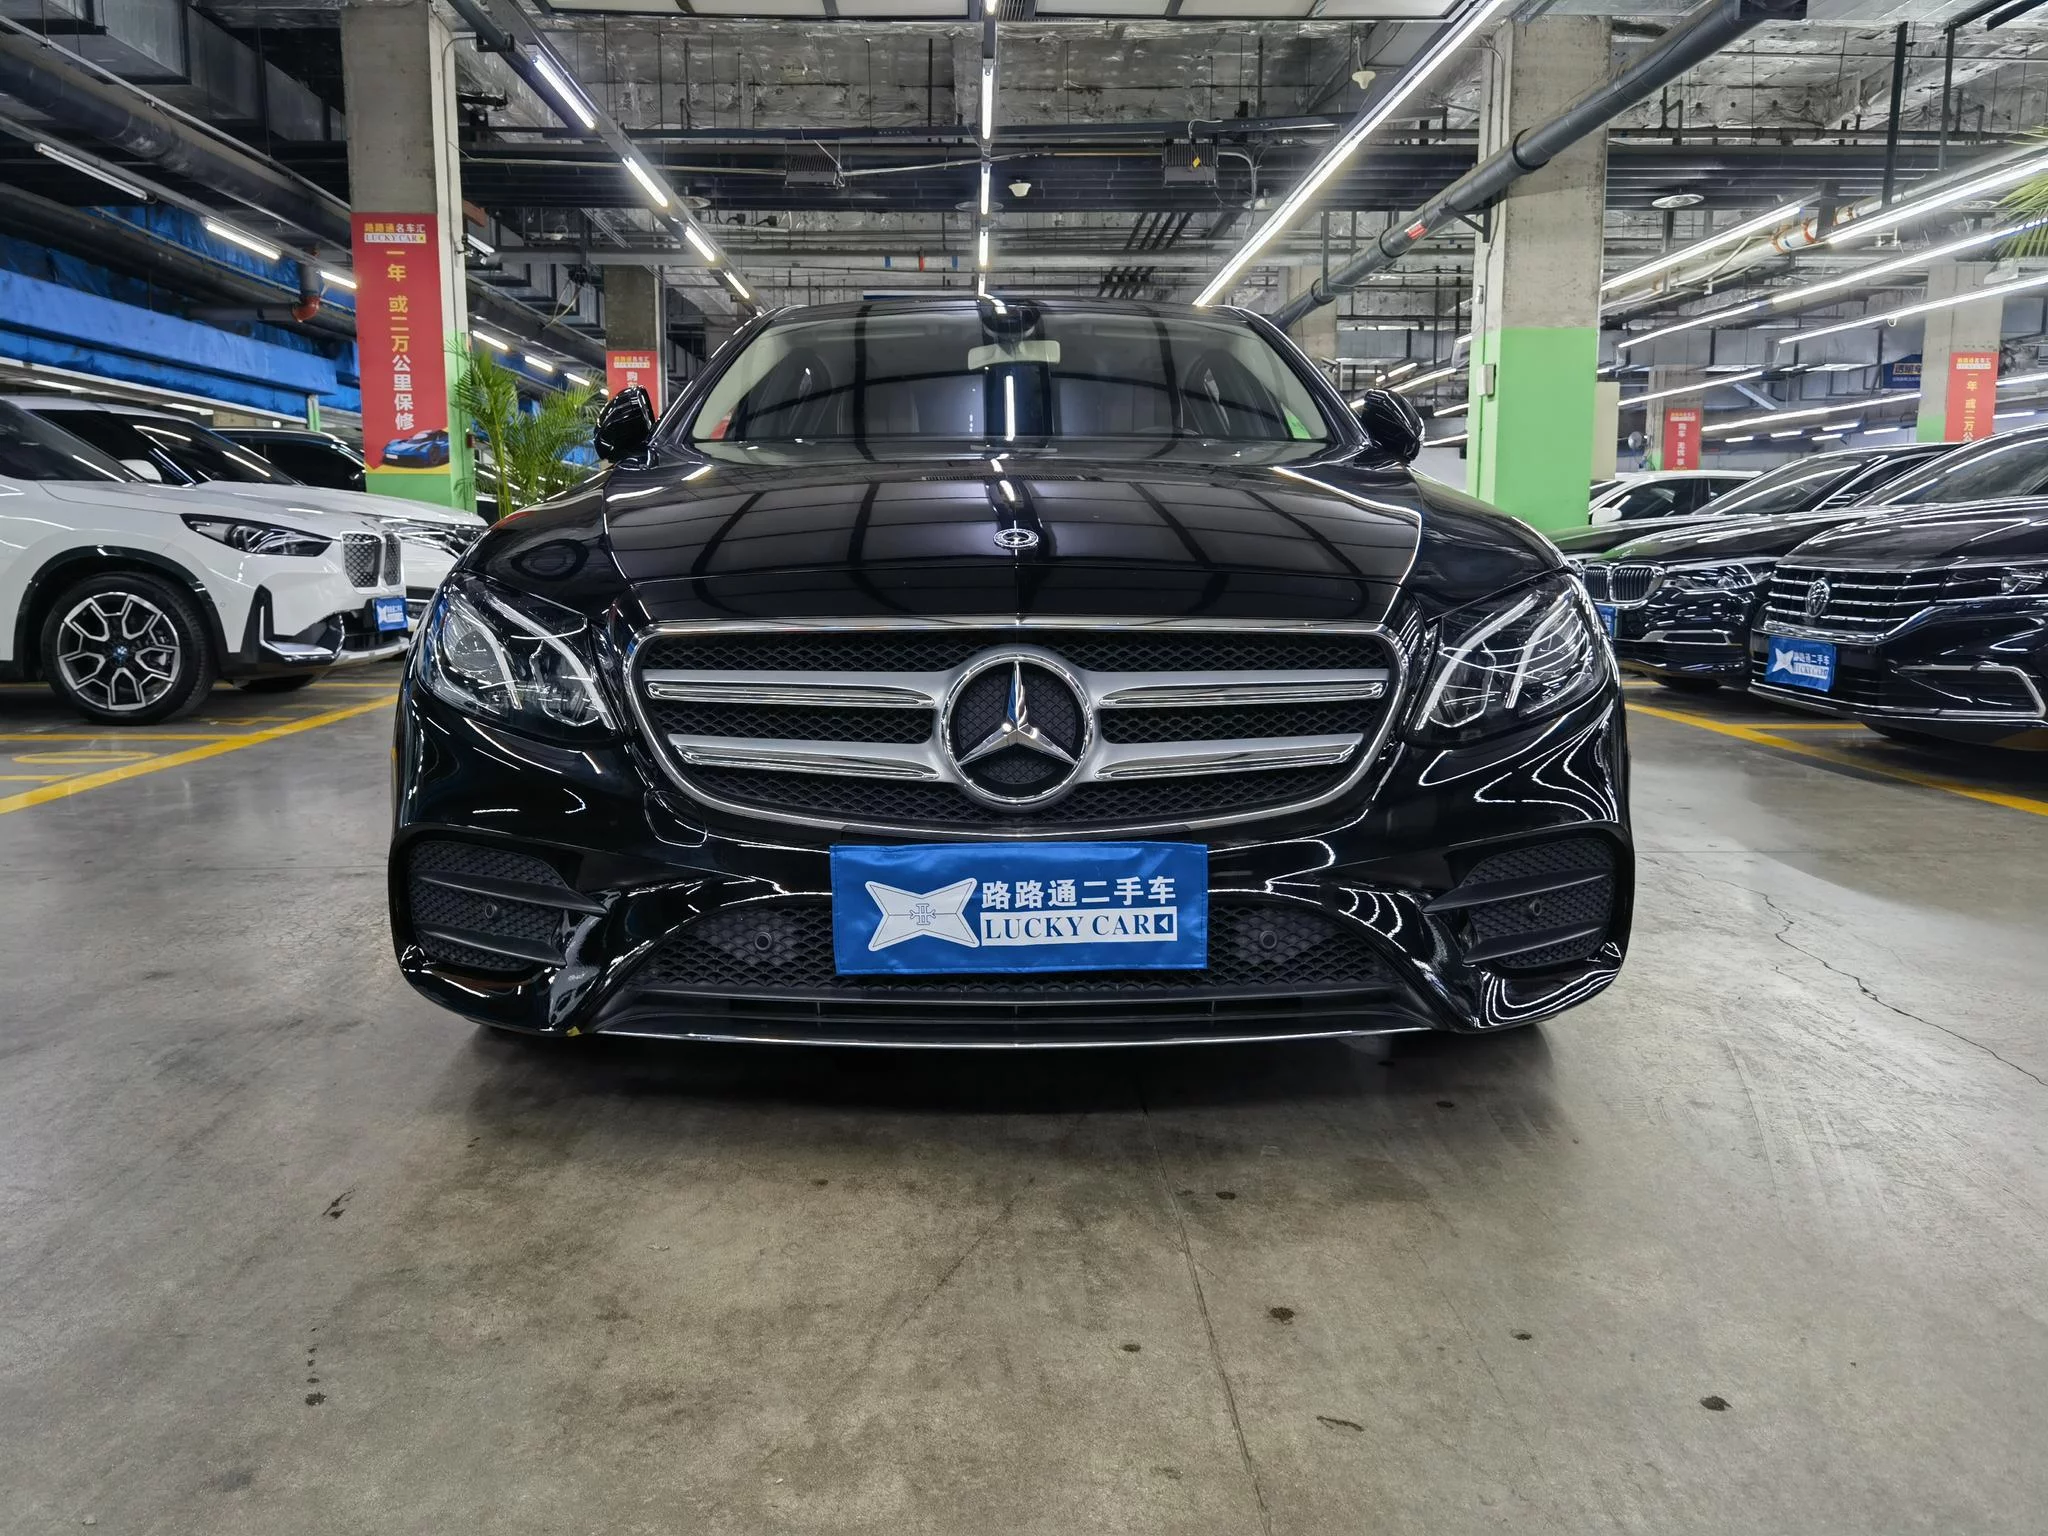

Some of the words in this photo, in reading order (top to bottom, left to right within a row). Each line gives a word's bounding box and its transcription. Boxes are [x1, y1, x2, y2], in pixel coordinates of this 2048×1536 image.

[981, 876, 1177, 910] 路路通二手车
[984, 915, 1084, 940] LUCKY
[1091, 913, 1151, 936] CAR
